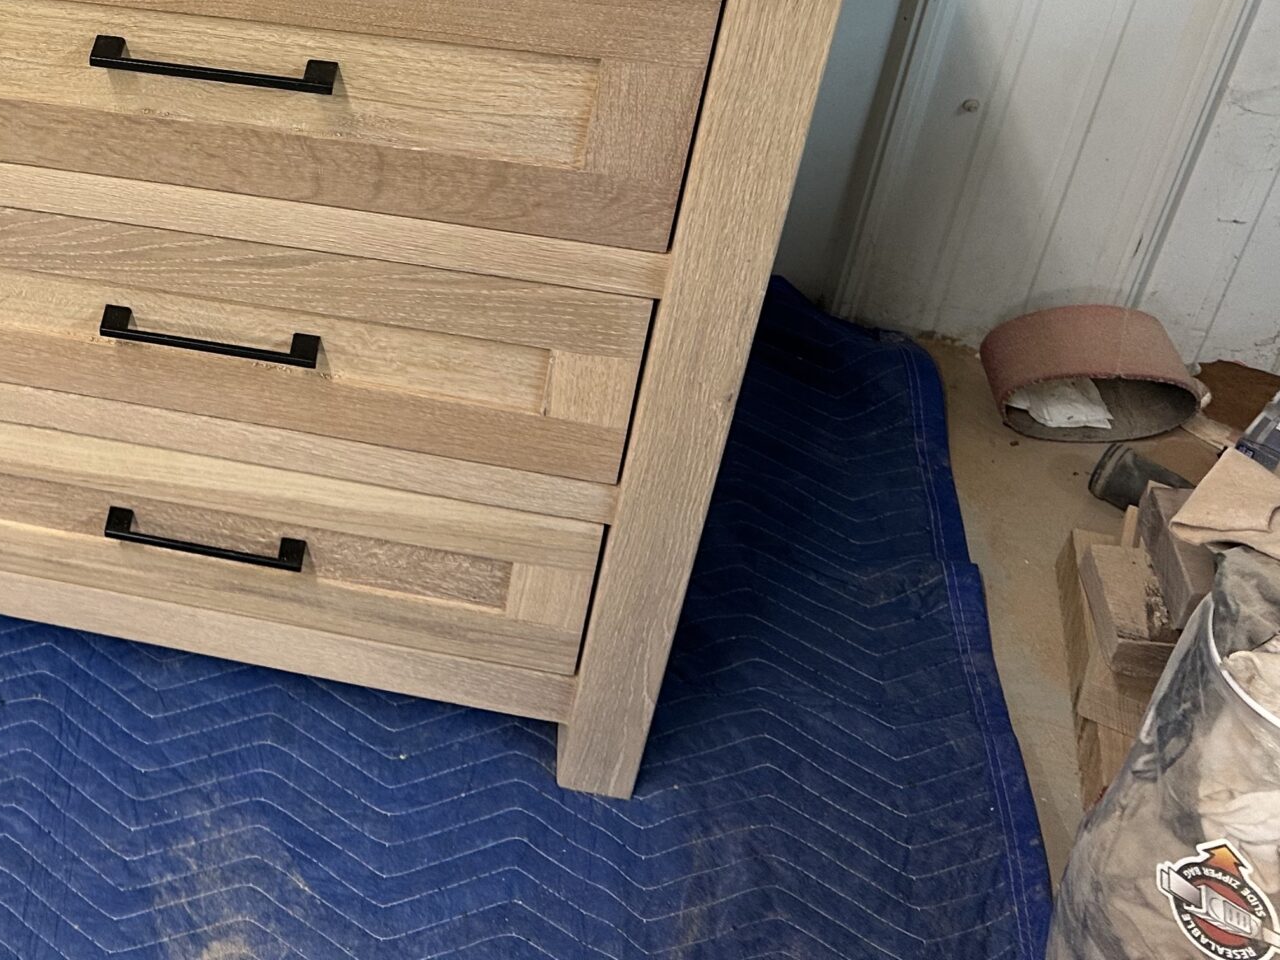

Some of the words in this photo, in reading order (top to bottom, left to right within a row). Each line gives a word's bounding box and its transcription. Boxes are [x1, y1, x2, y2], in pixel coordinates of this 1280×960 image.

[1183, 866, 1202, 879] BAG
[1202, 867, 1241, 889] ZIPPER
[1241, 888, 1266, 919] SLIDE
[1181, 913, 1257, 959] RESEALABLE
